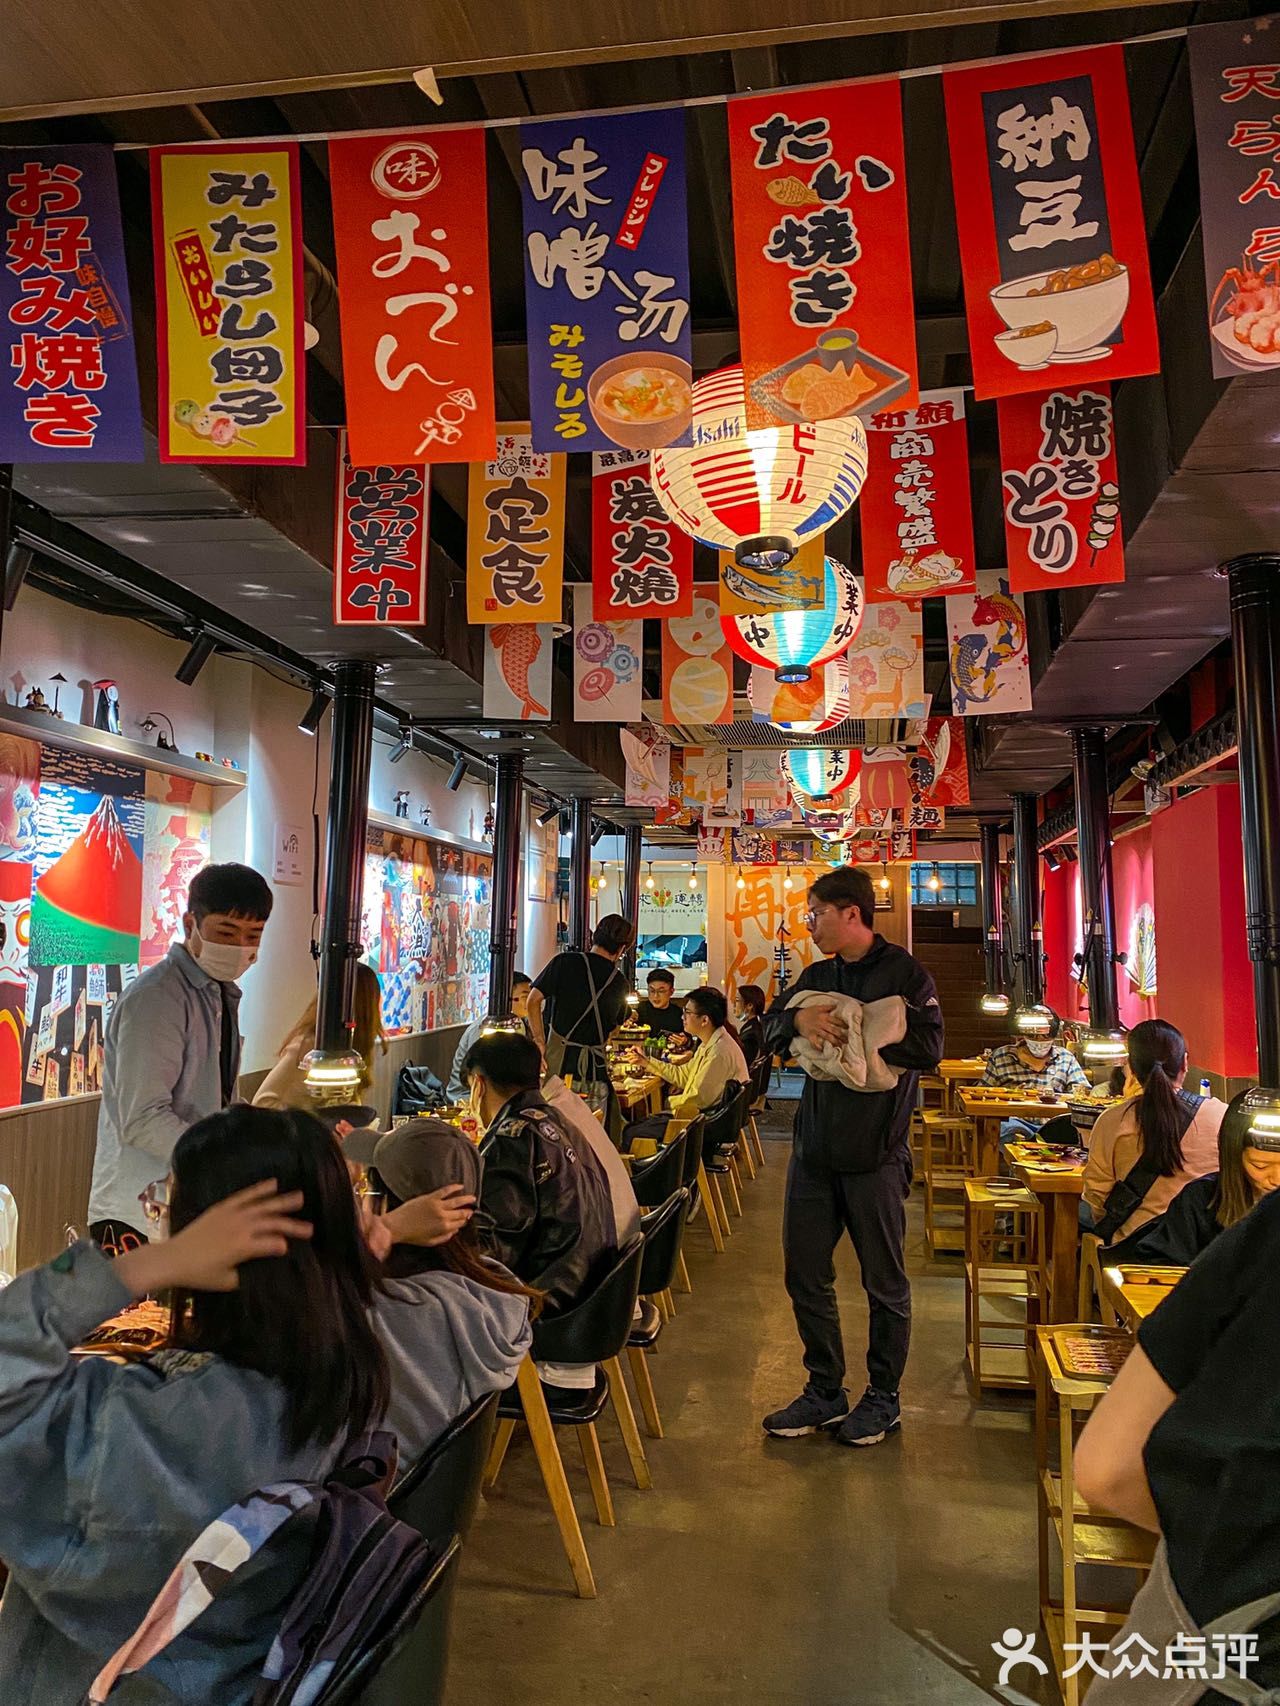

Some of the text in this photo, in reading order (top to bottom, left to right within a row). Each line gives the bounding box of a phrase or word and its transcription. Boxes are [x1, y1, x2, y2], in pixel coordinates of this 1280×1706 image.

[385, 154, 430, 184] 味
[619, 157, 664, 246] フレッシュ
[750, 112, 894, 328] たい焼き
[996, 96, 1100, 252] 納豆
[5, 161, 107, 449] お好み焼き
[180, 243, 220, 334] おいしい
[204, 170, 284, 427] みたらし団子
[370, 209, 475, 392] おでん
[548, 324, 588, 440] みそしる
[654, 453, 702, 531] ビール
[776, 421, 818, 505] ビール
[889, 430, 938, 550] 商売繁盛
[1001, 390, 1113, 574] 焼きとり
[347, 465, 424, 621] 営業中
[481, 476, 551, 607] 定食
